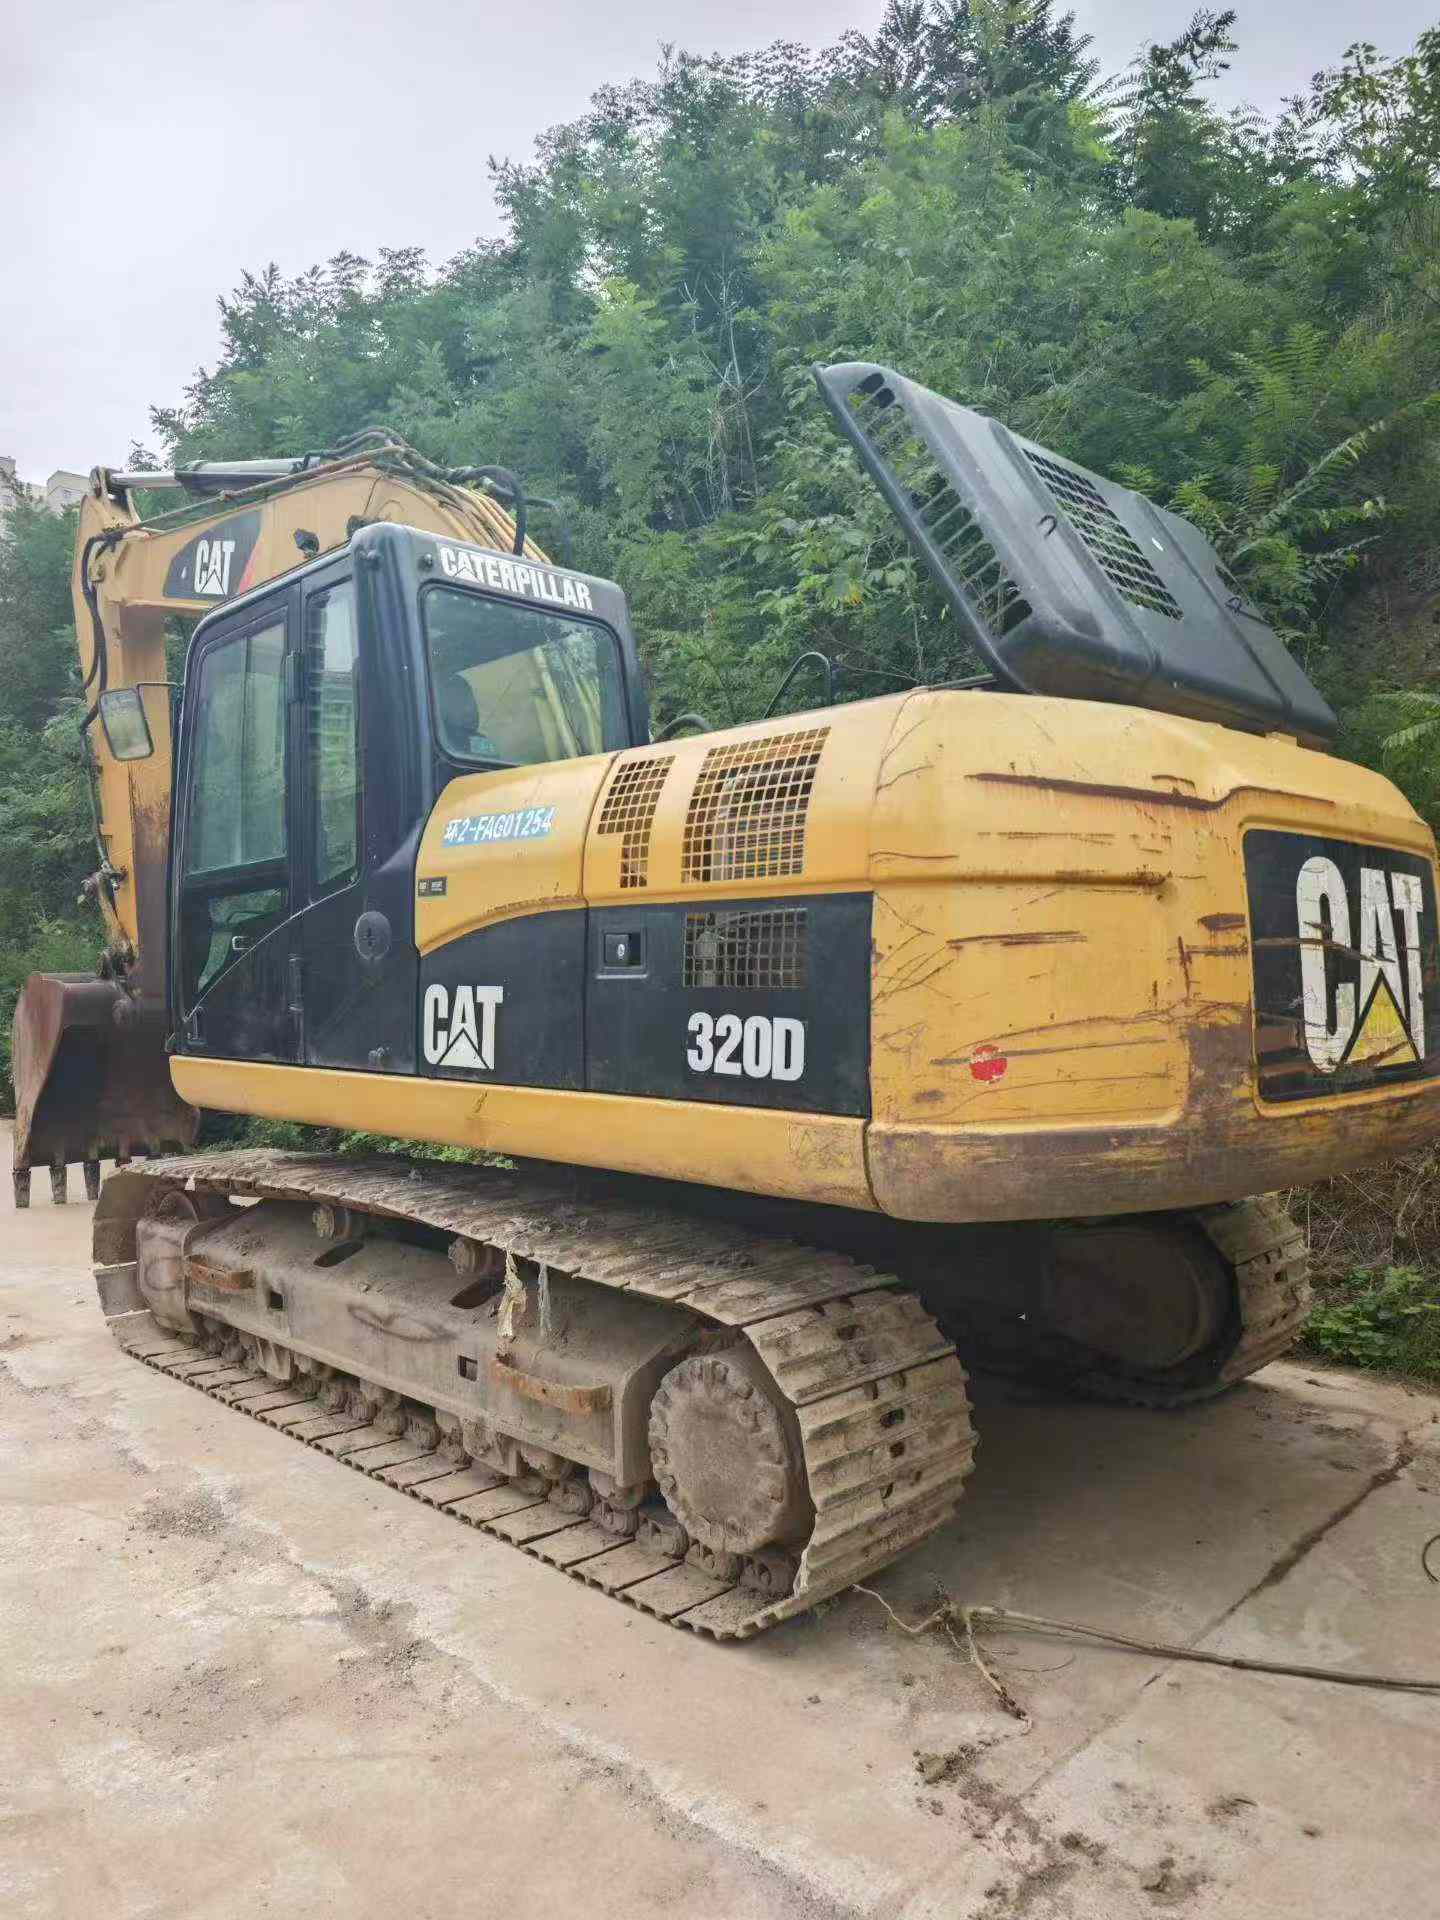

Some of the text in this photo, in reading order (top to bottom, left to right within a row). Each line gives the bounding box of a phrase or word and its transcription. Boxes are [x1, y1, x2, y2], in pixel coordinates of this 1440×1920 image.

[194, 539, 236, 595] CAT
[439, 547, 593, 611] CATERPILLAR
[1296, 855, 1426, 1074] CAT
[423, 983, 504, 1070] CAT
[687, 1011, 805, 1082] 320D
